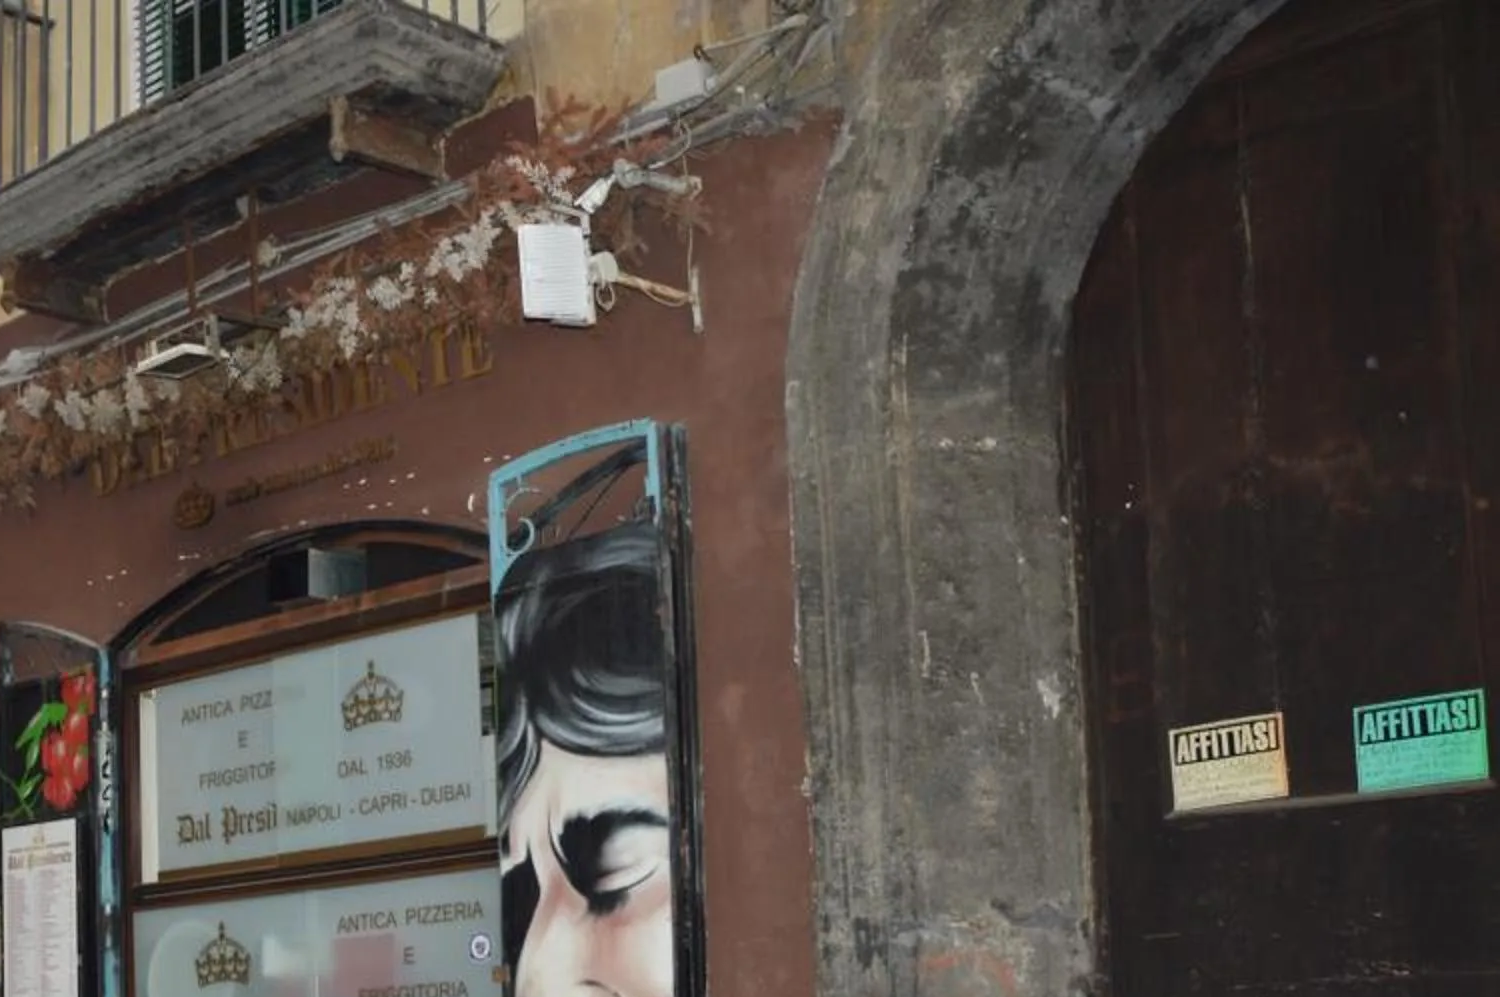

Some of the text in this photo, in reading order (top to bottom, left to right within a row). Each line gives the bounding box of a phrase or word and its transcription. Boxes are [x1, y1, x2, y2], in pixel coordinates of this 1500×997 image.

[181, 698, 233, 726] ANTICA
[1362, 697, 1477, 742] AFFITTASI
[238, 730, 248, 748] E
[1177, 719, 1277, 763] AFFITTASI
[337, 749, 412, 779] DAL 1936
[286, 782, 471, 827] NAPOLI CAPRI DUBAI
[177, 812, 211, 846] Dal
[337, 900, 484, 934] ANTICA PIZZERIA
[403, 947, 414, 965] E
